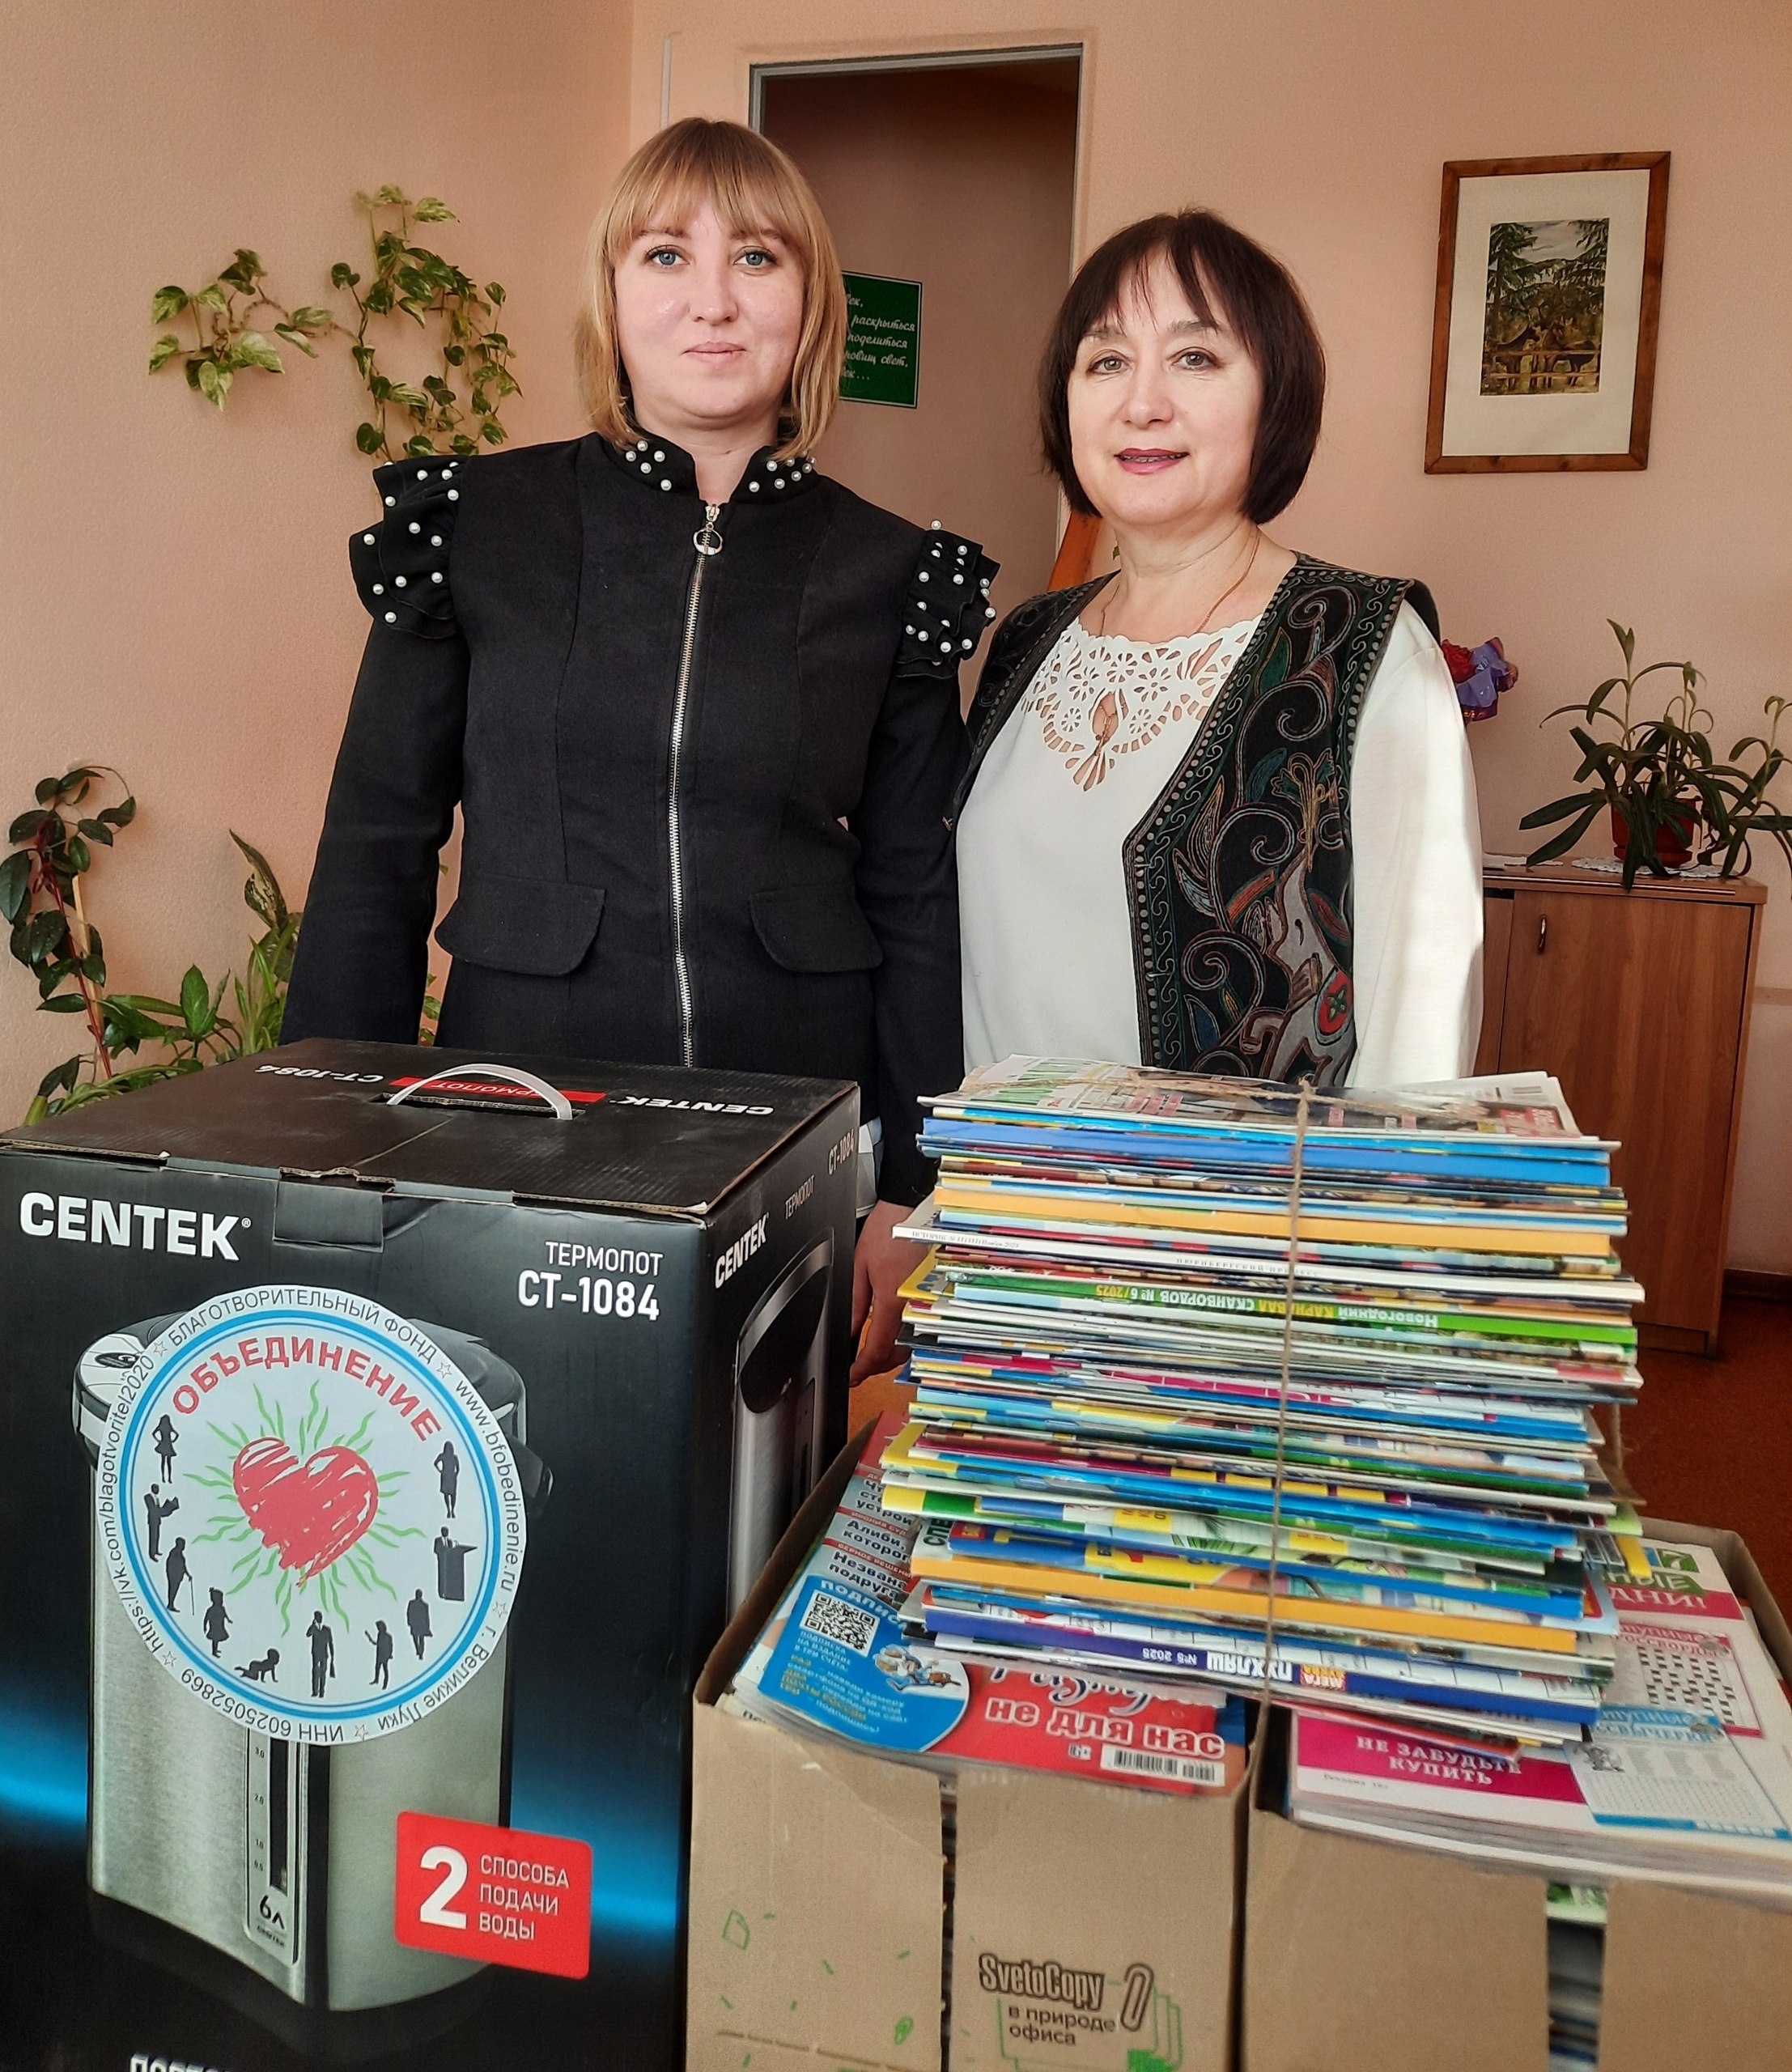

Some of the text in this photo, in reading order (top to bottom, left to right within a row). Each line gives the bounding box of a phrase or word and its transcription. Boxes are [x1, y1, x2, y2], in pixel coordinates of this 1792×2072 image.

[847, 332, 907, 349] поделиться
[851, 314, 915, 332] раскрыться
[783, 1174, 816, 1220] ТЕРМОПОТ
[545, 1240, 664, 1277] ТЕРМОПОТ
[1160, 1290, 1255, 1311] СКАНВОРДОВ
[1338, 1306, 1438, 1327] Новогодний
[169, 1289, 438, 1365] БЛАГОТВОРИТЕЛЬНЫЙ ФОНД
[172, 1336, 442, 1441] ОБЪЕДИНЕНИЕ
[456, 1380, 522, 1592] www.bfobedinenie.ru
[98, 1355, 165, 1653] https://vk.com/blagotvoritel2020
[847, 1520, 906, 1550] Алиби,
[423, 1644, 490, 1707] Великие
[180, 1668, 344, 1743] ИНН 6025052869
[377, 1699, 419, 1731] Луки
[1143, 1722, 1226, 1760] нас
[1356, 1734, 1389, 1754] НЕ
[1389, 1756, 1493, 1785] КУПИТЬ
[419, 1845, 469, 1930] 2
[480, 1853, 570, 1889] СПОСОБА
[479, 1883, 558, 1917] ПОДАЧИ
[478, 1913, 535, 1942] ВОДЫ
[979, 1952, 1105, 2011] SvetoCopy
[1009, 2006, 1117, 2033] в природе
[1009, 2023, 1076, 2046] офиса
